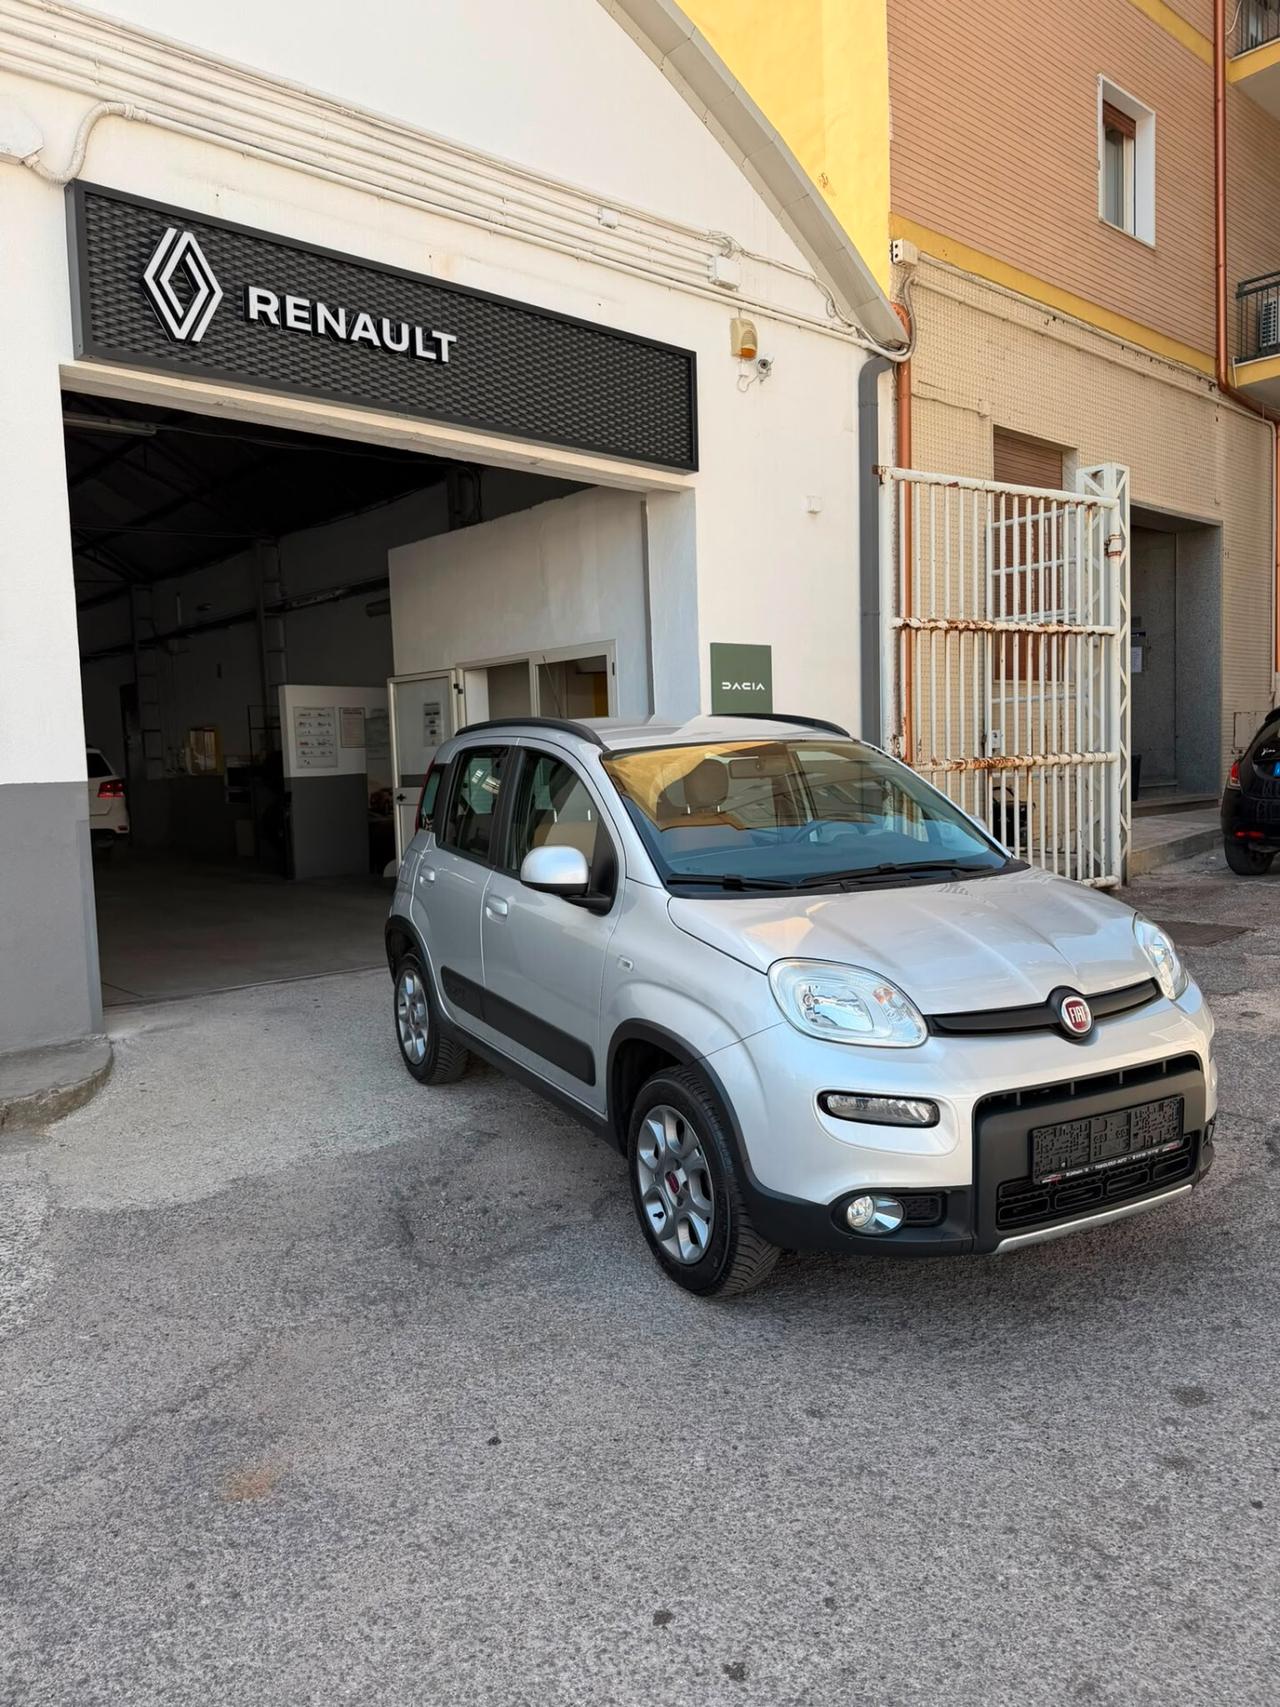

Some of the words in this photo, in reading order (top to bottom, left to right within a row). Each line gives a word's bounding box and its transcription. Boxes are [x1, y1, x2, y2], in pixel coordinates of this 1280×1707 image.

[248, 286, 457, 363] RENAULT
[721, 681, 765, 691] DACIA
[1068, 1006, 1087, 1024] FIAT
